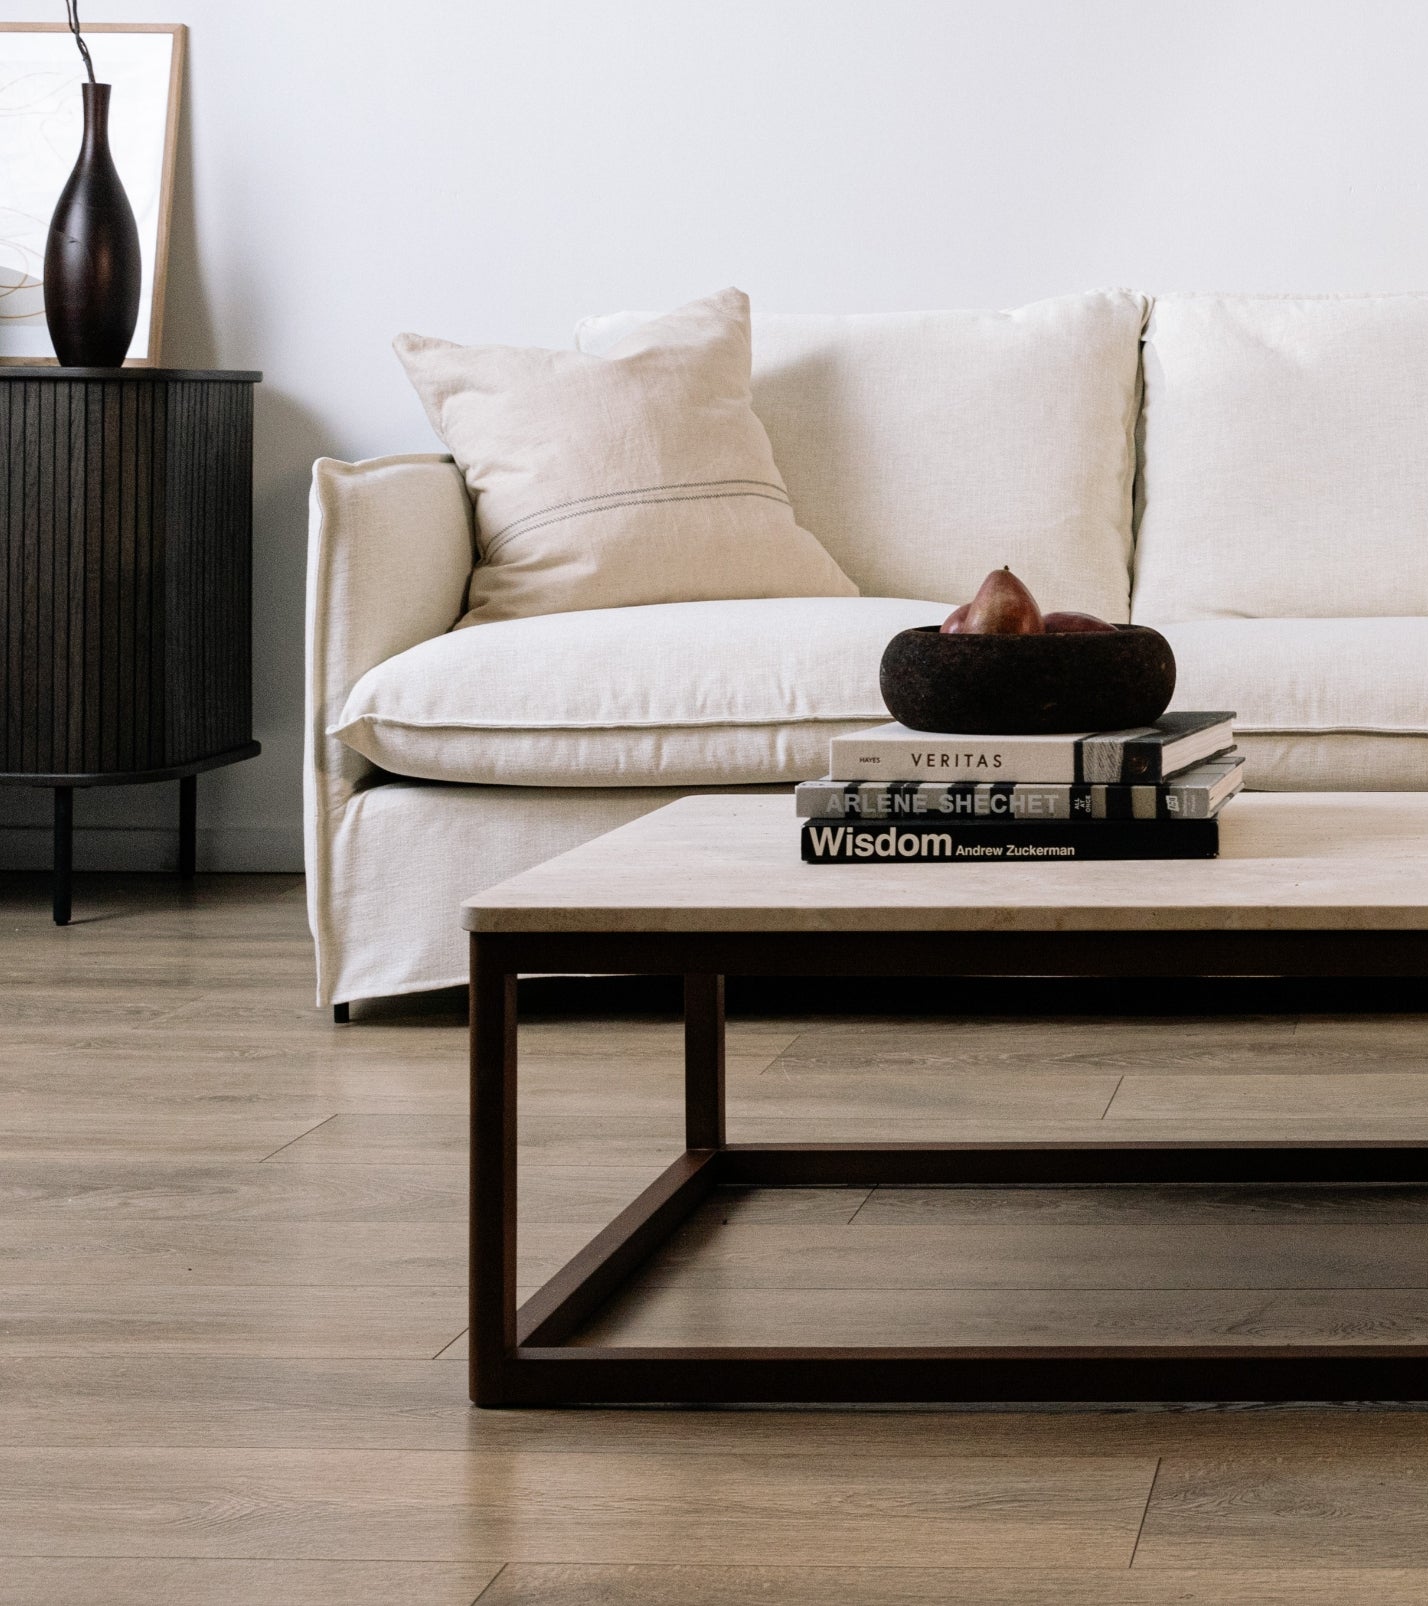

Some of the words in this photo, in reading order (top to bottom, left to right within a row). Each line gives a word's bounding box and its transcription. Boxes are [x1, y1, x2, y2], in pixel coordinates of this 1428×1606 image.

[911, 753, 1003, 768] VERITAS
[825, 793, 928, 813] ARLENE
[939, 793, 1059, 813] SHECHET
[1080, 800, 1085, 808] AT
[808, 826, 953, 857] Wisdom
[955, 844, 1003, 856] Andrew
[1006, 844, 1075, 856] Zuckerman
